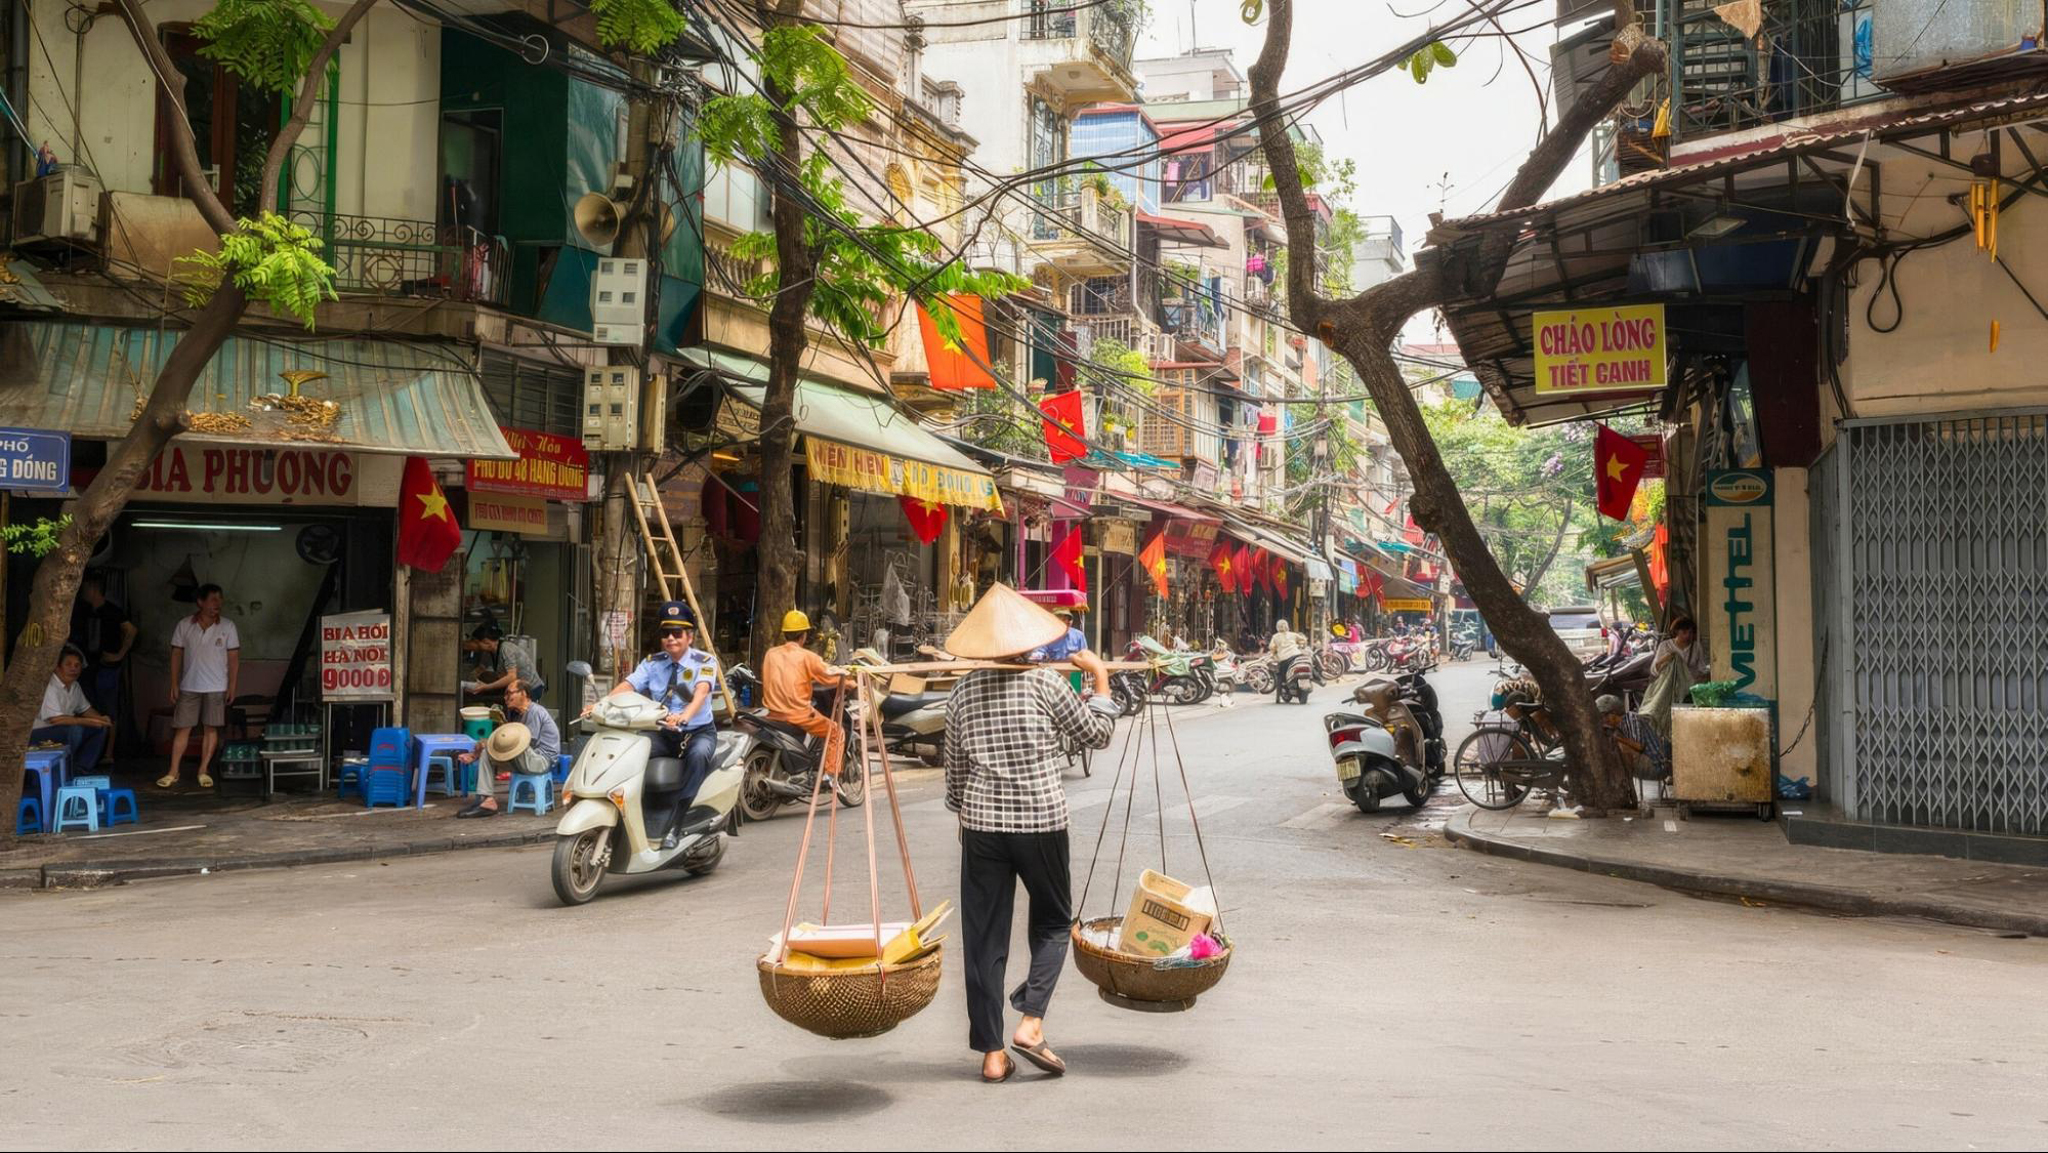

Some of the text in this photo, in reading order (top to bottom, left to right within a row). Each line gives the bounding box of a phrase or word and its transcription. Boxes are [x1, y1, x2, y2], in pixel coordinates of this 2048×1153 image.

[1540, 312, 1656, 355] CHÁO LÒNG
[1549, 358, 1590, 387] TIẾT
[323, 626, 355, 641] BIA
